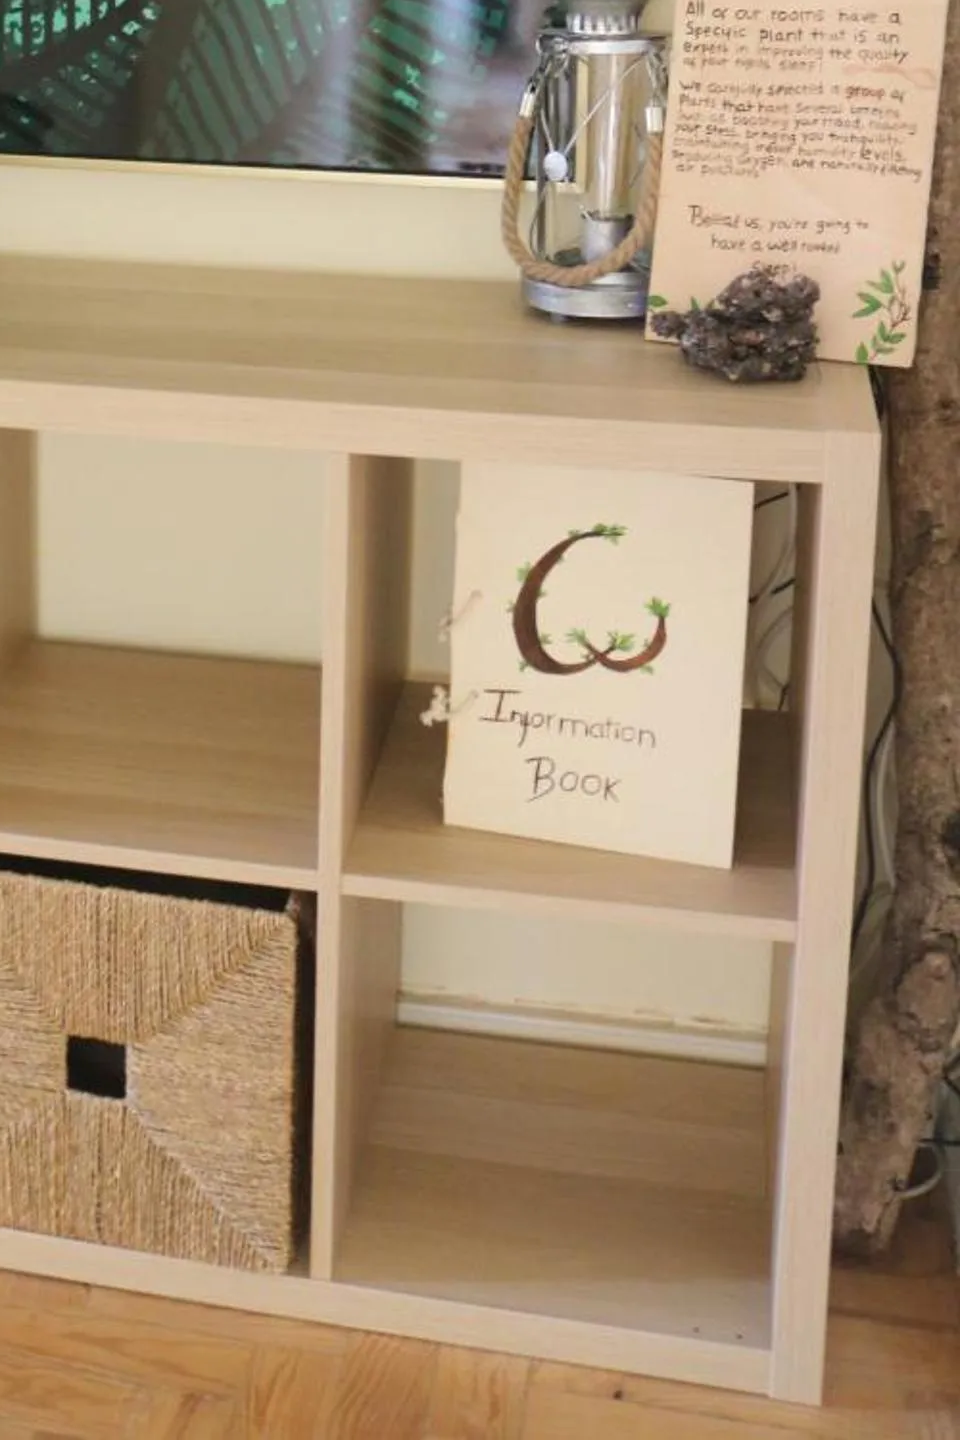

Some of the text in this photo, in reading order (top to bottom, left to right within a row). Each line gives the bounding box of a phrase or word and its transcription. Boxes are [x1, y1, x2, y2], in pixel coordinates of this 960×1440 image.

[685, 0, 705, 16] All
[771, 9, 825, 22] rooms
[888, 12, 901, 26] a
[711, 233, 746, 251] have
[751, 238, 763, 251] a
